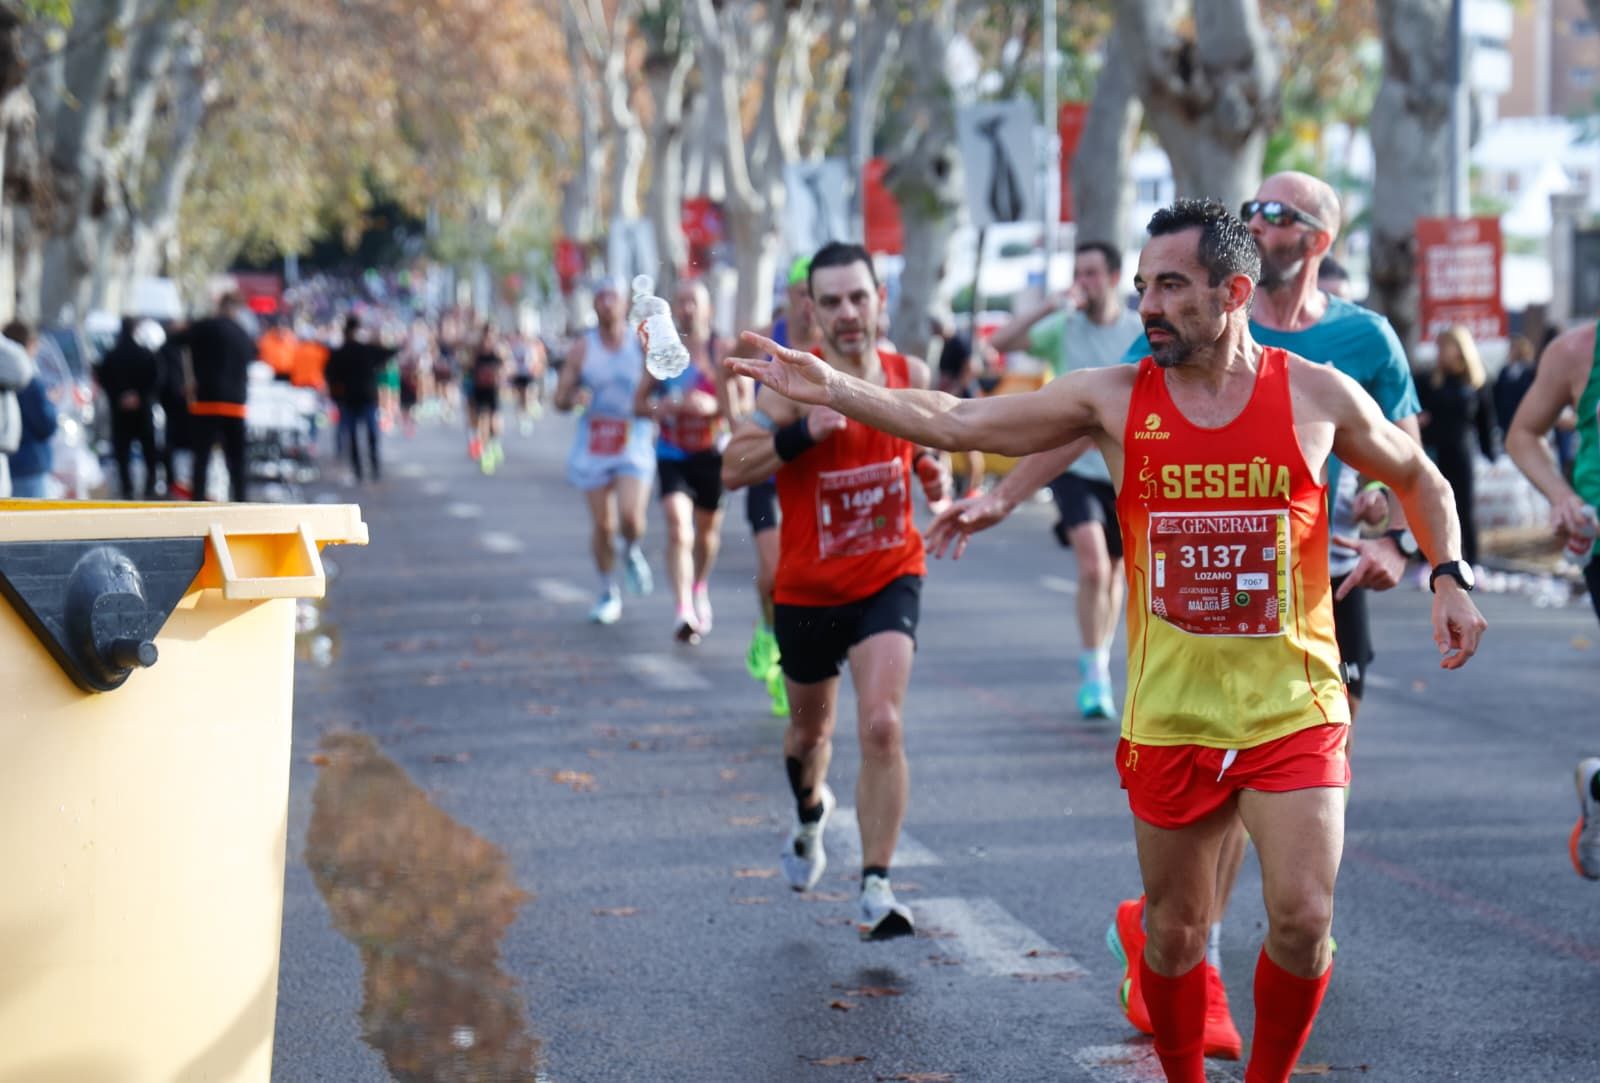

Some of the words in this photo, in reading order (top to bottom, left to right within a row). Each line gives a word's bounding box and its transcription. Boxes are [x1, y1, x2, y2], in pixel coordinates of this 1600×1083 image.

[1134, 431, 1171, 440] VIATOR
[1161, 456, 1291, 500] SESEÑA
[1182, 516, 1268, 534] GENERALI
[1180, 544, 1247, 568] 3137
[1194, 571, 1232, 581] LOZANO
[1242, 578, 1264, 586] 7067
